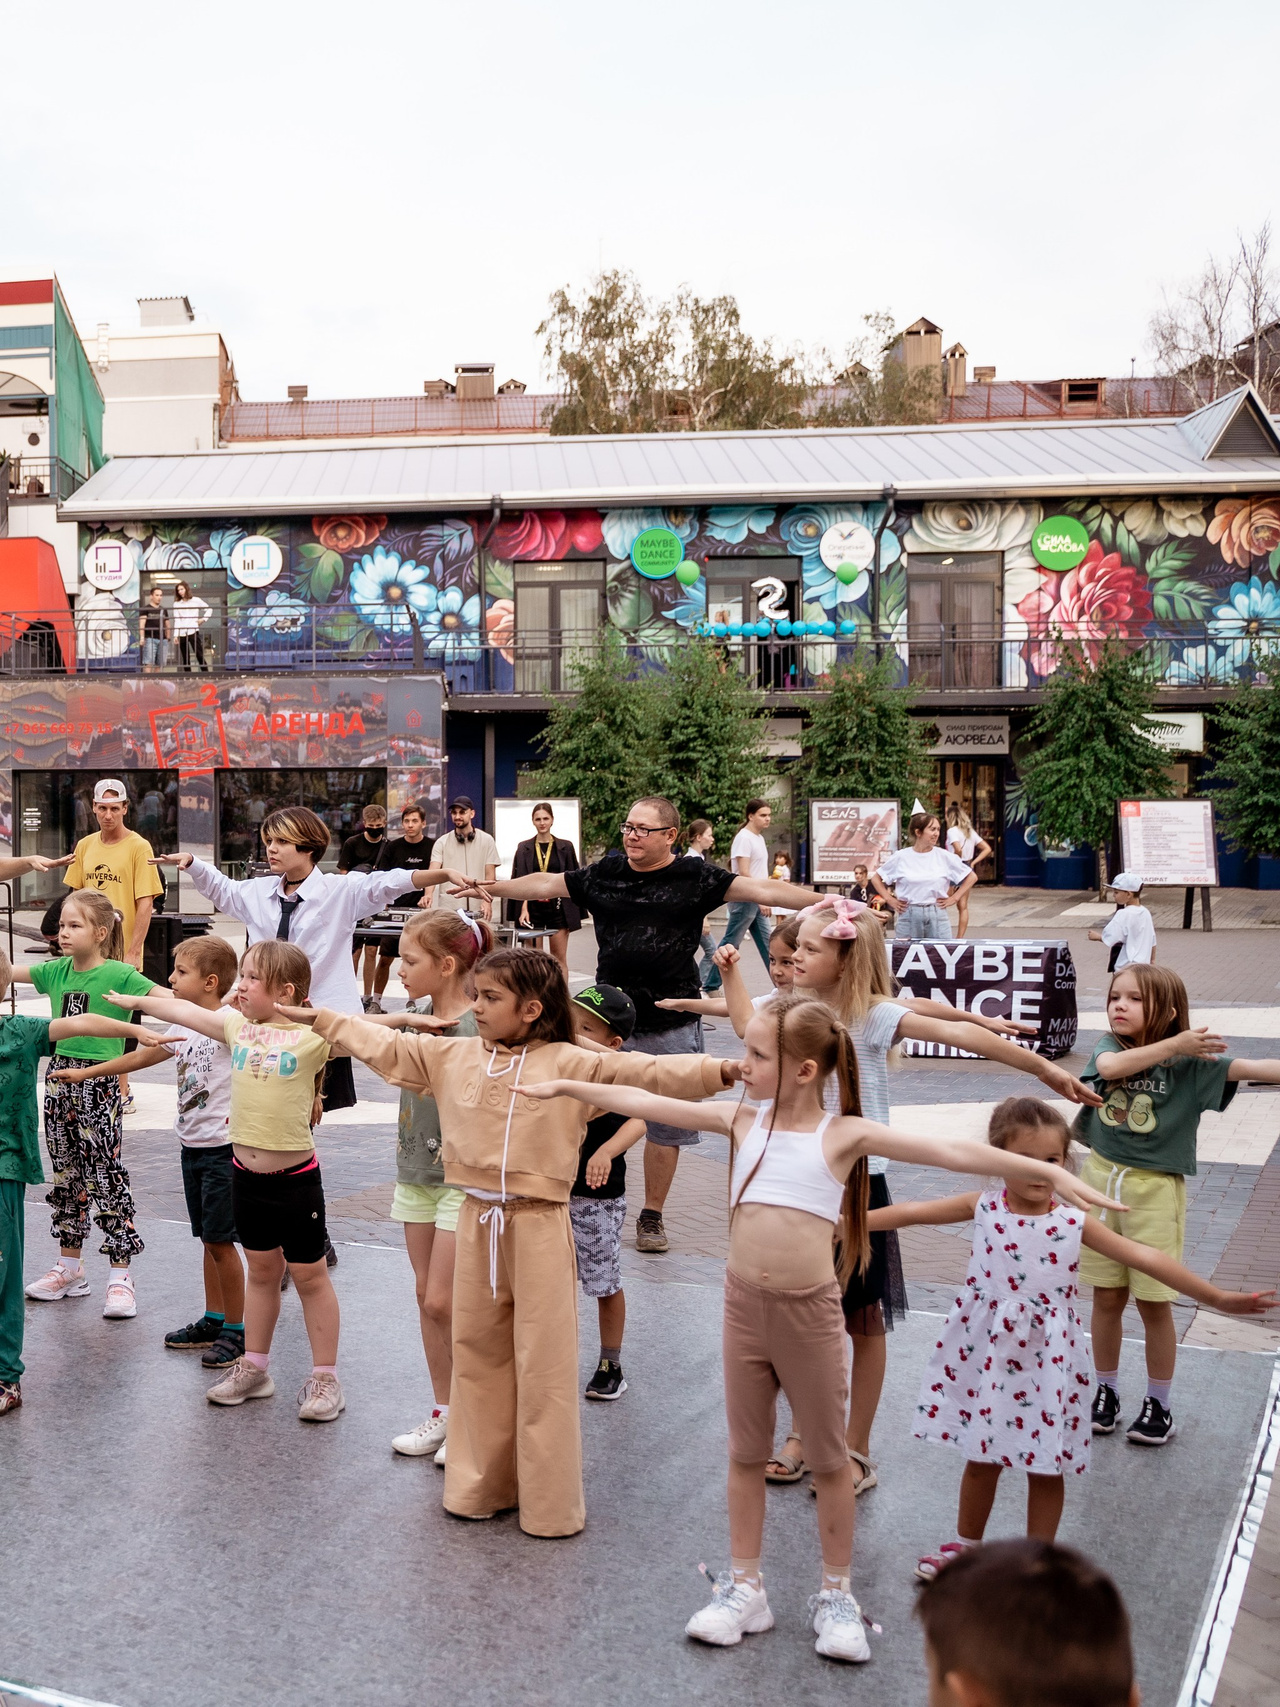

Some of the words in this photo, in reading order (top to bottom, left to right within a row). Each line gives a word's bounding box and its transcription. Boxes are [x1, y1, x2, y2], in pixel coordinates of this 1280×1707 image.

[640, 539, 675, 548] MAYBE
[640, 550, 675, 559] DANCE
[4, 723, 19, 734] +7
[23, 723, 47, 734] 965
[50, 723, 75, 734] 669
[78, 723, 93, 734] 75
[251, 713, 366, 738] АРЕНДА
[944, 734, 1005, 745] АЮРВЕДА
[821, 807, 858, 819] SENS
[238, 1023, 301, 1046] SUNNY
[198, 1038, 212, 1049] JUST
[195, 1046, 215, 1057] ENJOY
[196, 1063, 213, 1072] RIDE
